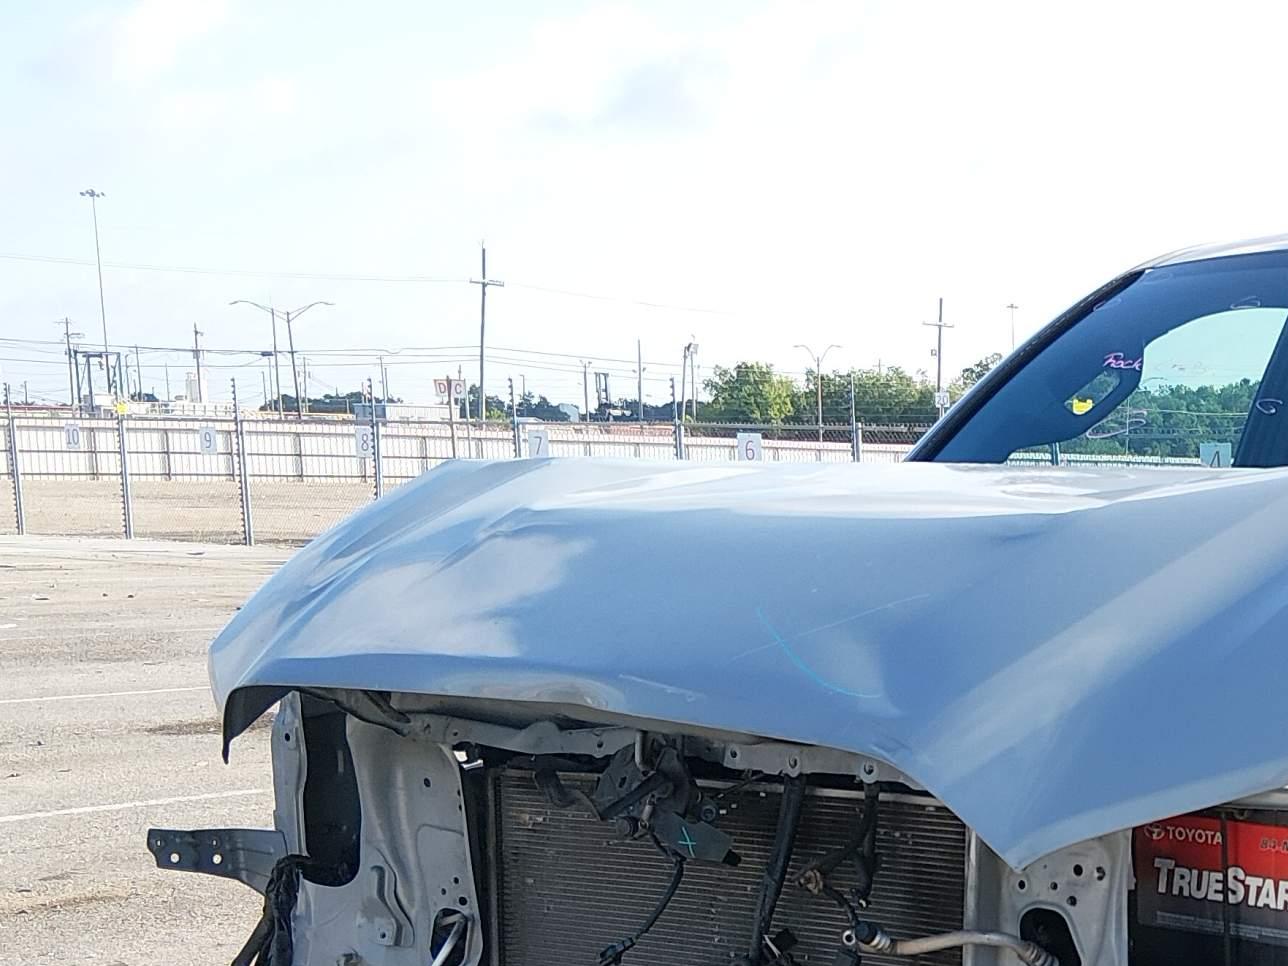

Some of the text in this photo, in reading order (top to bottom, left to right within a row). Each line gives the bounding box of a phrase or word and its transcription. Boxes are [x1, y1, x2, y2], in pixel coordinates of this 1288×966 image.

[454, 383, 462, 395] C
[65, 428, 80, 446] 10
[204, 431, 212, 449] 9
[361, 433, 369, 452] 8
[534, 436, 543, 455] 7
[745, 440, 755, 461] 6
[1167, 825, 1223, 846] TOYOTA
